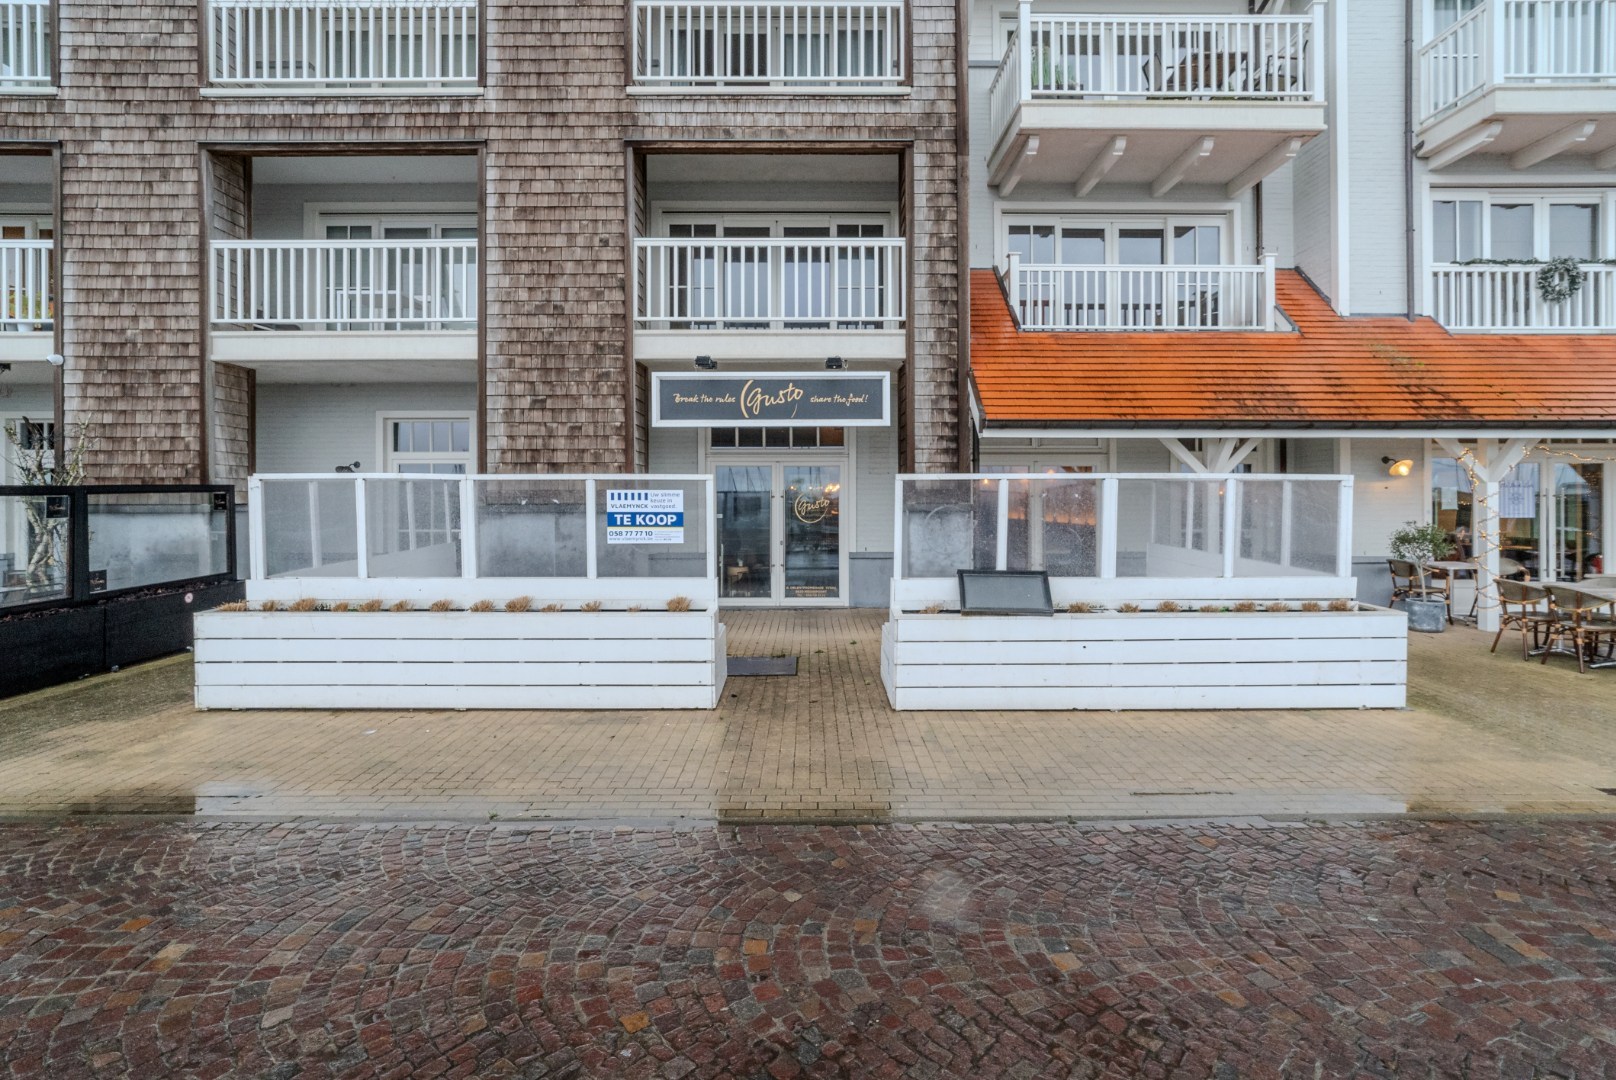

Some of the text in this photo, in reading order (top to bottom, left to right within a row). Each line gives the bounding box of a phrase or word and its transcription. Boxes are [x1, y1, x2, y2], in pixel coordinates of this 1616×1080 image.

[673, 393, 699, 403] Break
[700, 393, 713, 403] the
[715, 393, 736, 403] rules
[810, 395, 831, 403] share
[833, 393, 846, 403] the
[846, 393, 869, 407] food!
[614, 514, 677, 525] TE KOOP
